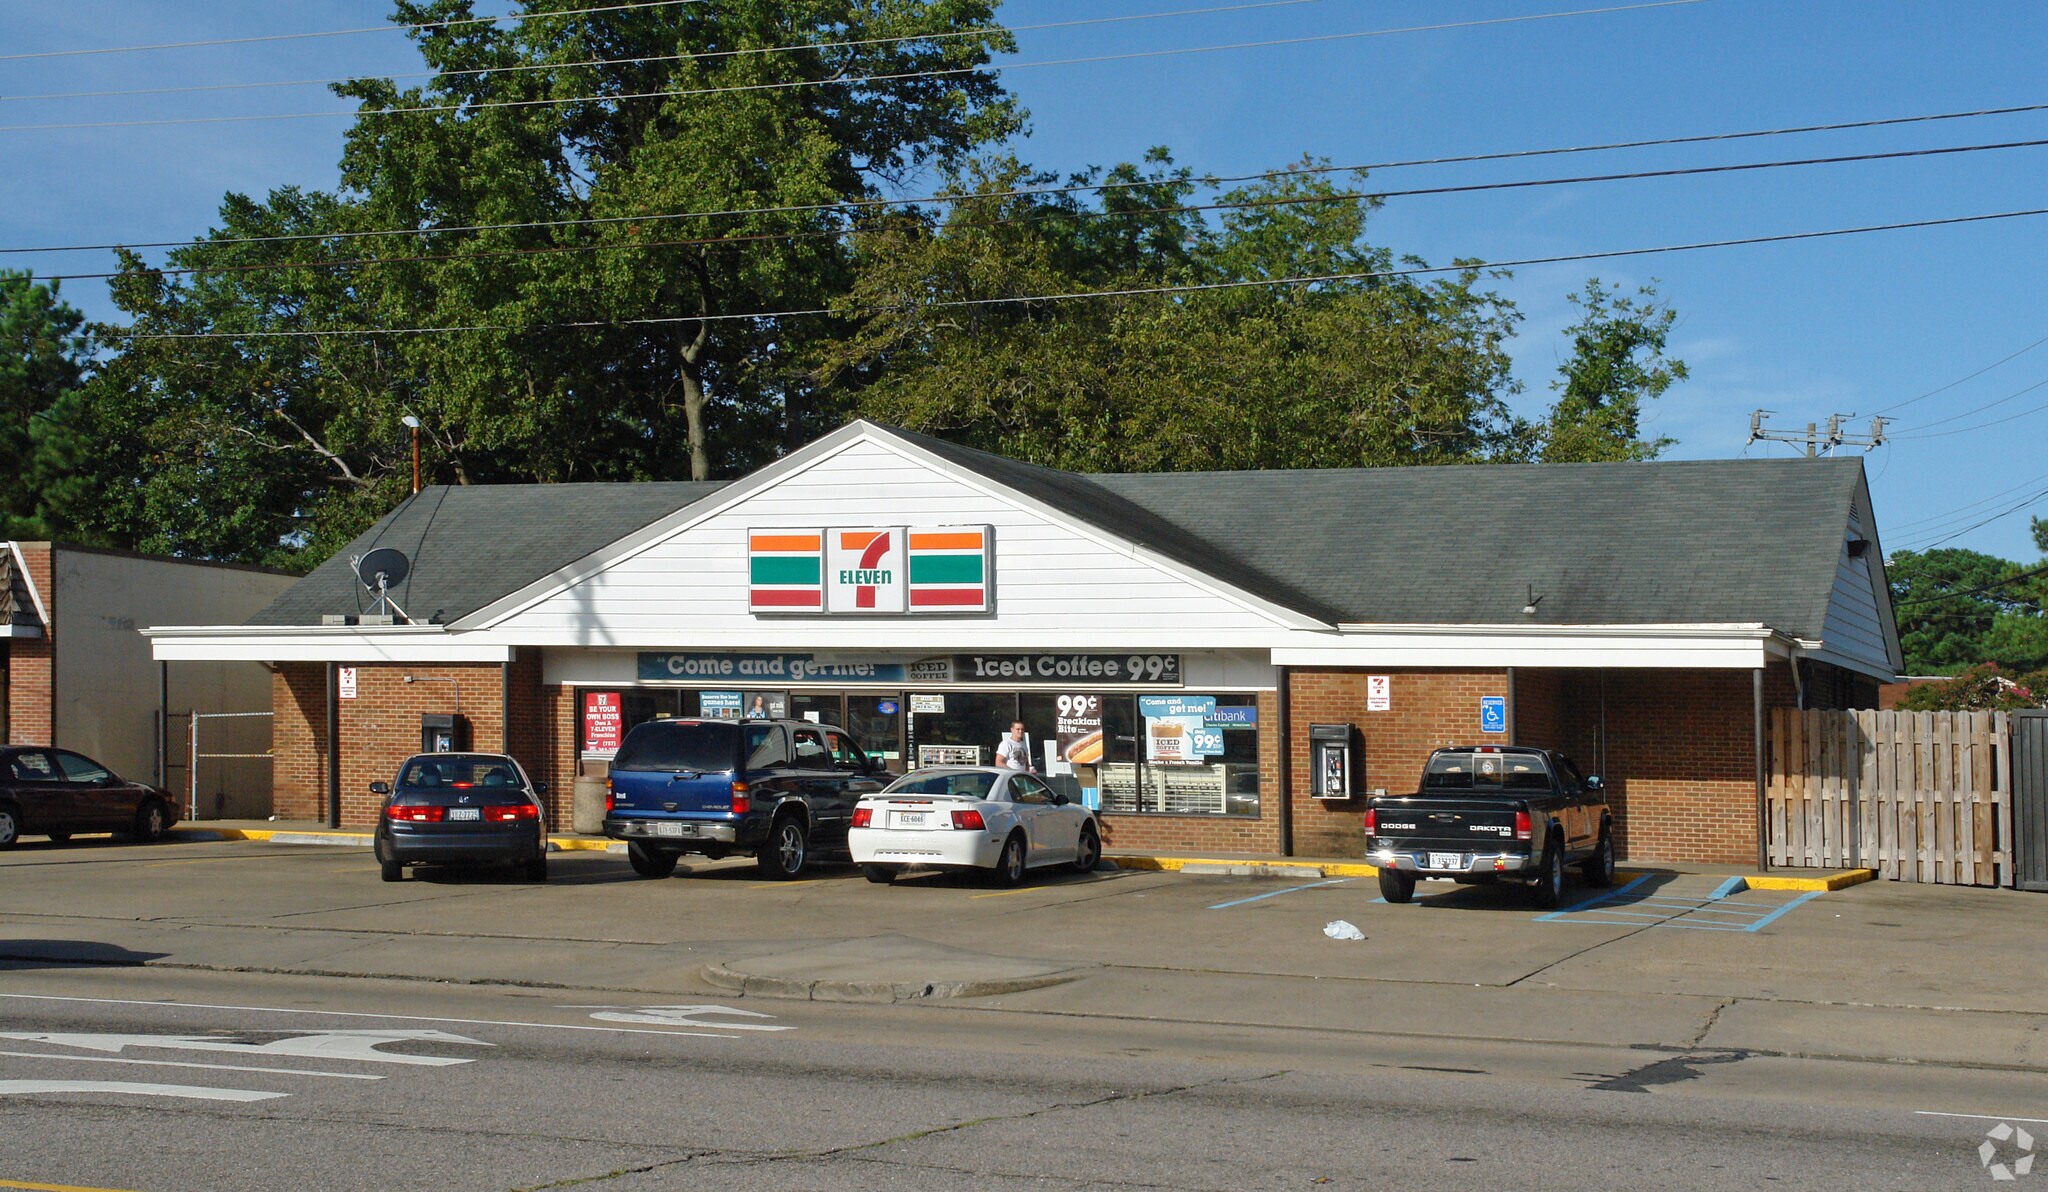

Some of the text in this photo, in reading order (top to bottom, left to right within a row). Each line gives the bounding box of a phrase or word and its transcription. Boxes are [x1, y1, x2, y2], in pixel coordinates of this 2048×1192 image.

[841, 531, 890, 608] 7
[738, 657, 784, 675] and
[910, 662, 947, 672] ICED
[974, 657, 1031, 676] Iced
[1036, 656, 1119, 676] Coffee
[910, 672, 947, 680] COFFEE
[1169, 704, 1187, 714] get
[1058, 717, 1101, 726] Breakfast
[1058, 725, 1077, 733] Bite
